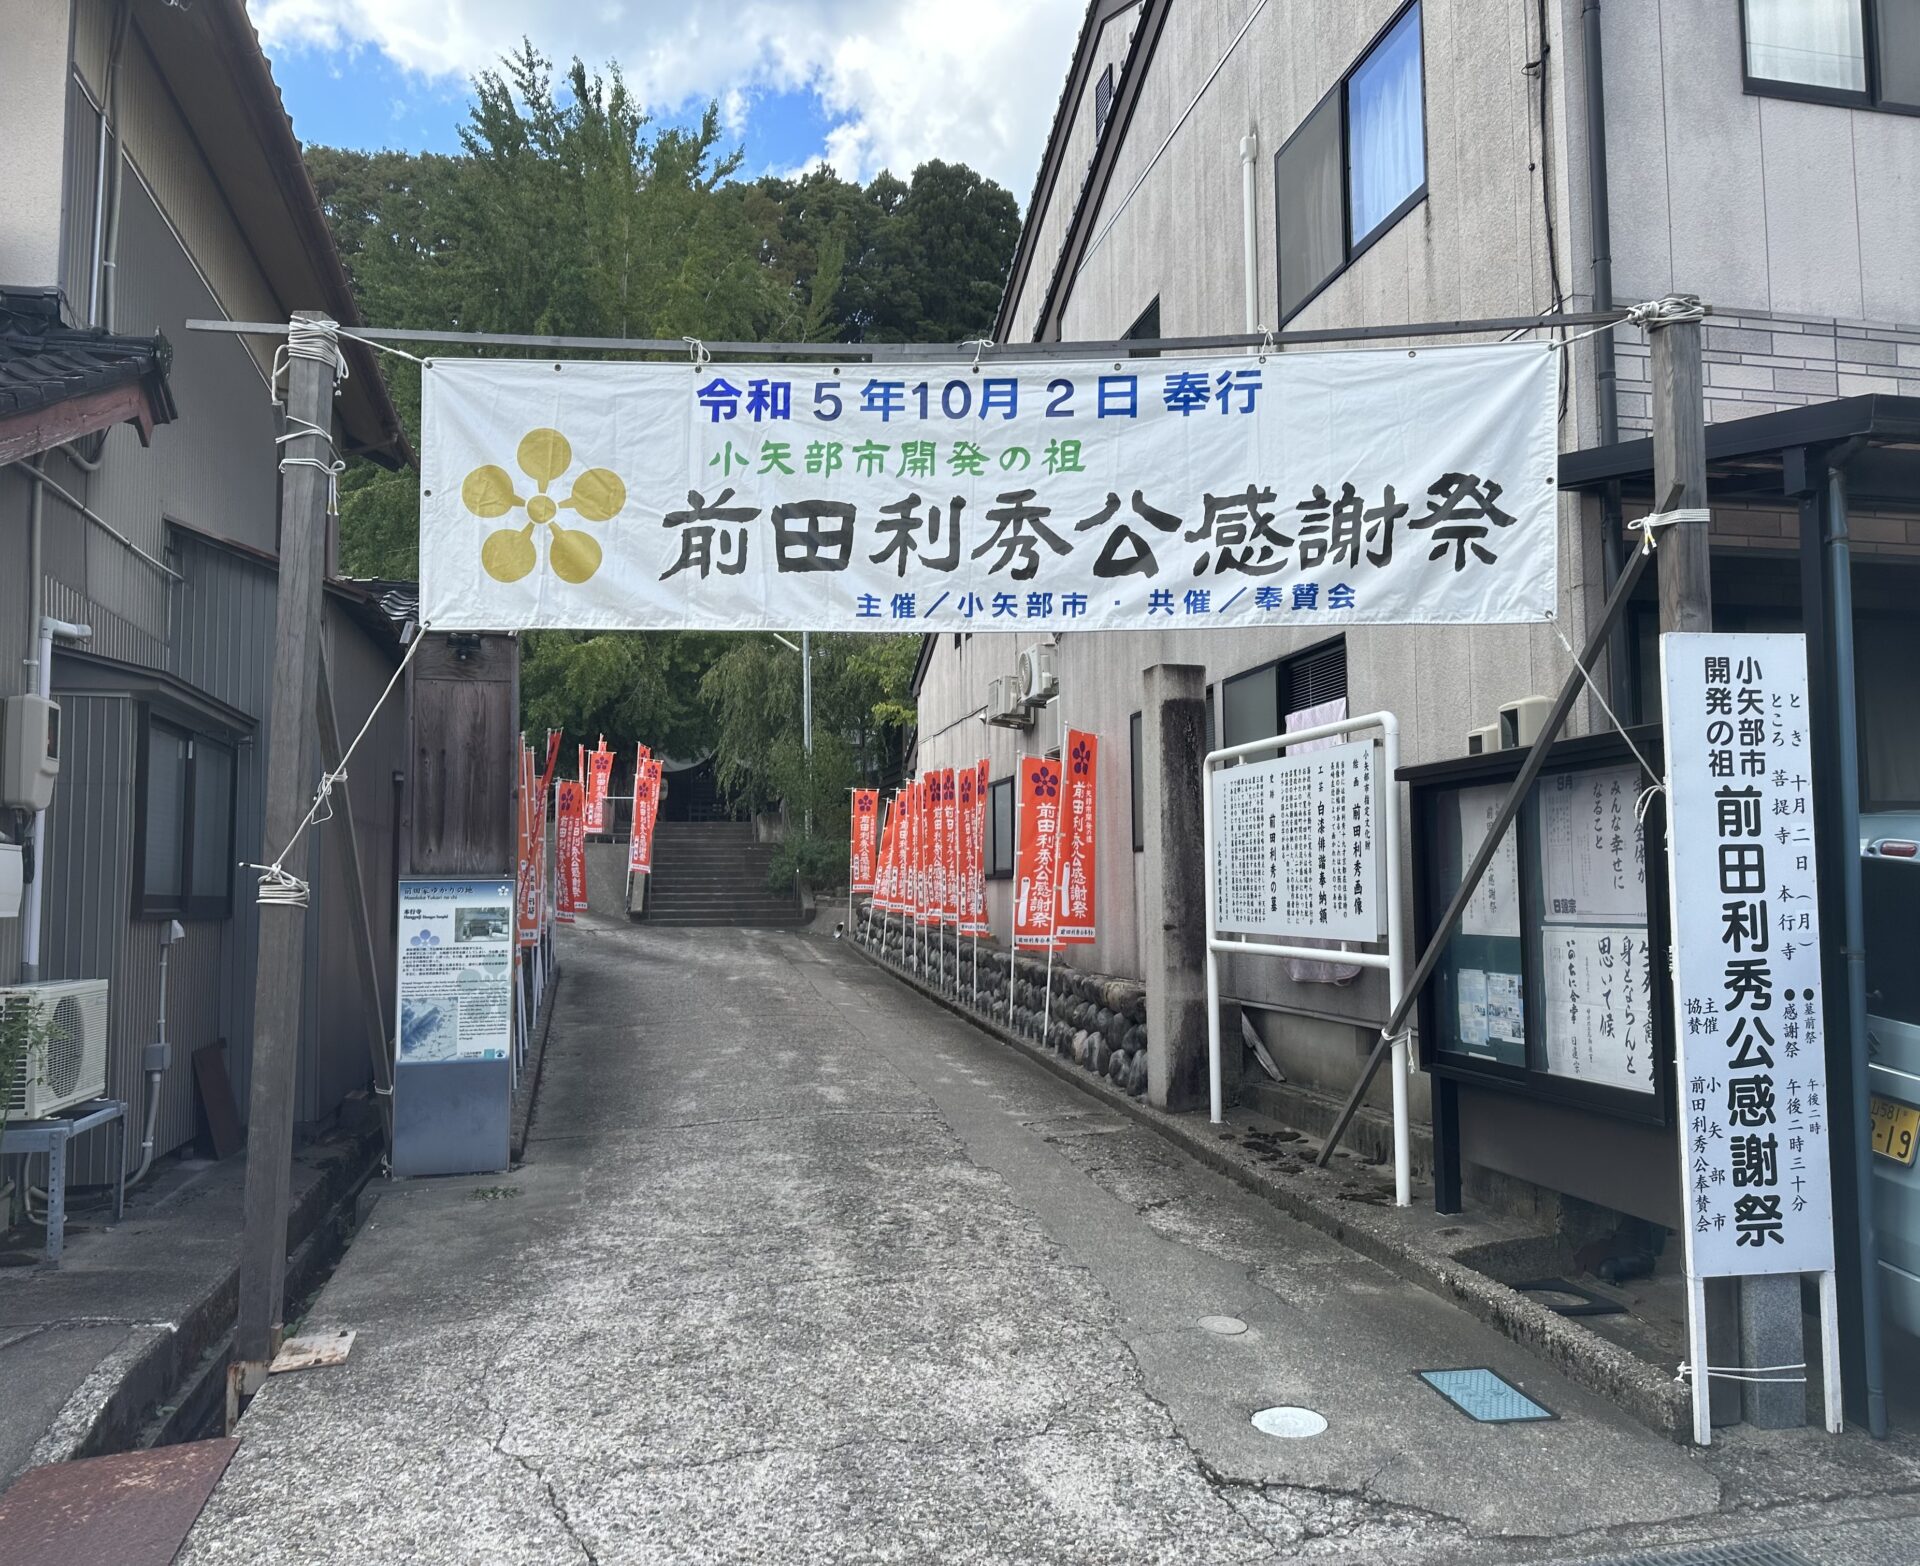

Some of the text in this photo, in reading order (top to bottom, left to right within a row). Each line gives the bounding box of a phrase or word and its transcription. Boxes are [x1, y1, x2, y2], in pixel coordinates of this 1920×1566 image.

[709, 439, 1087, 478] 小矢部市開発の祖
[659, 472, 1517, 580] 前田利秀公感謝祭
[1704, 656, 1735, 778] 開発の祖
[1736, 656, 1766, 778] 小矢部市
[1029, 802, 1057, 928] 前田利秀公感謝祭
[1071, 781, 1088, 918] 前田利秀公感謝祭
[1269, 813, 1278, 912] 前田利秀の墓
[1352, 802, 1363, 916] 前田利秀画像
[1593, 781, 1603, 850] なること
[1610, 780, 1625, 890] みんな幸せに
[1771, 693, 1808, 1212] ところ 菩提寺 本行寺 感謝祭 午後二時三十分
[1702, 998, 1719, 1035] 主催
[1714, 785, 1785, 1248] 前田利秀公感謝祭
[1804, 1003, 1817, 1044] 墓前祭
[1687, 998, 1712, 1233] 協賛 前田利秀公奉賛会
[1807, 1078, 1822, 1135] 午後二時
